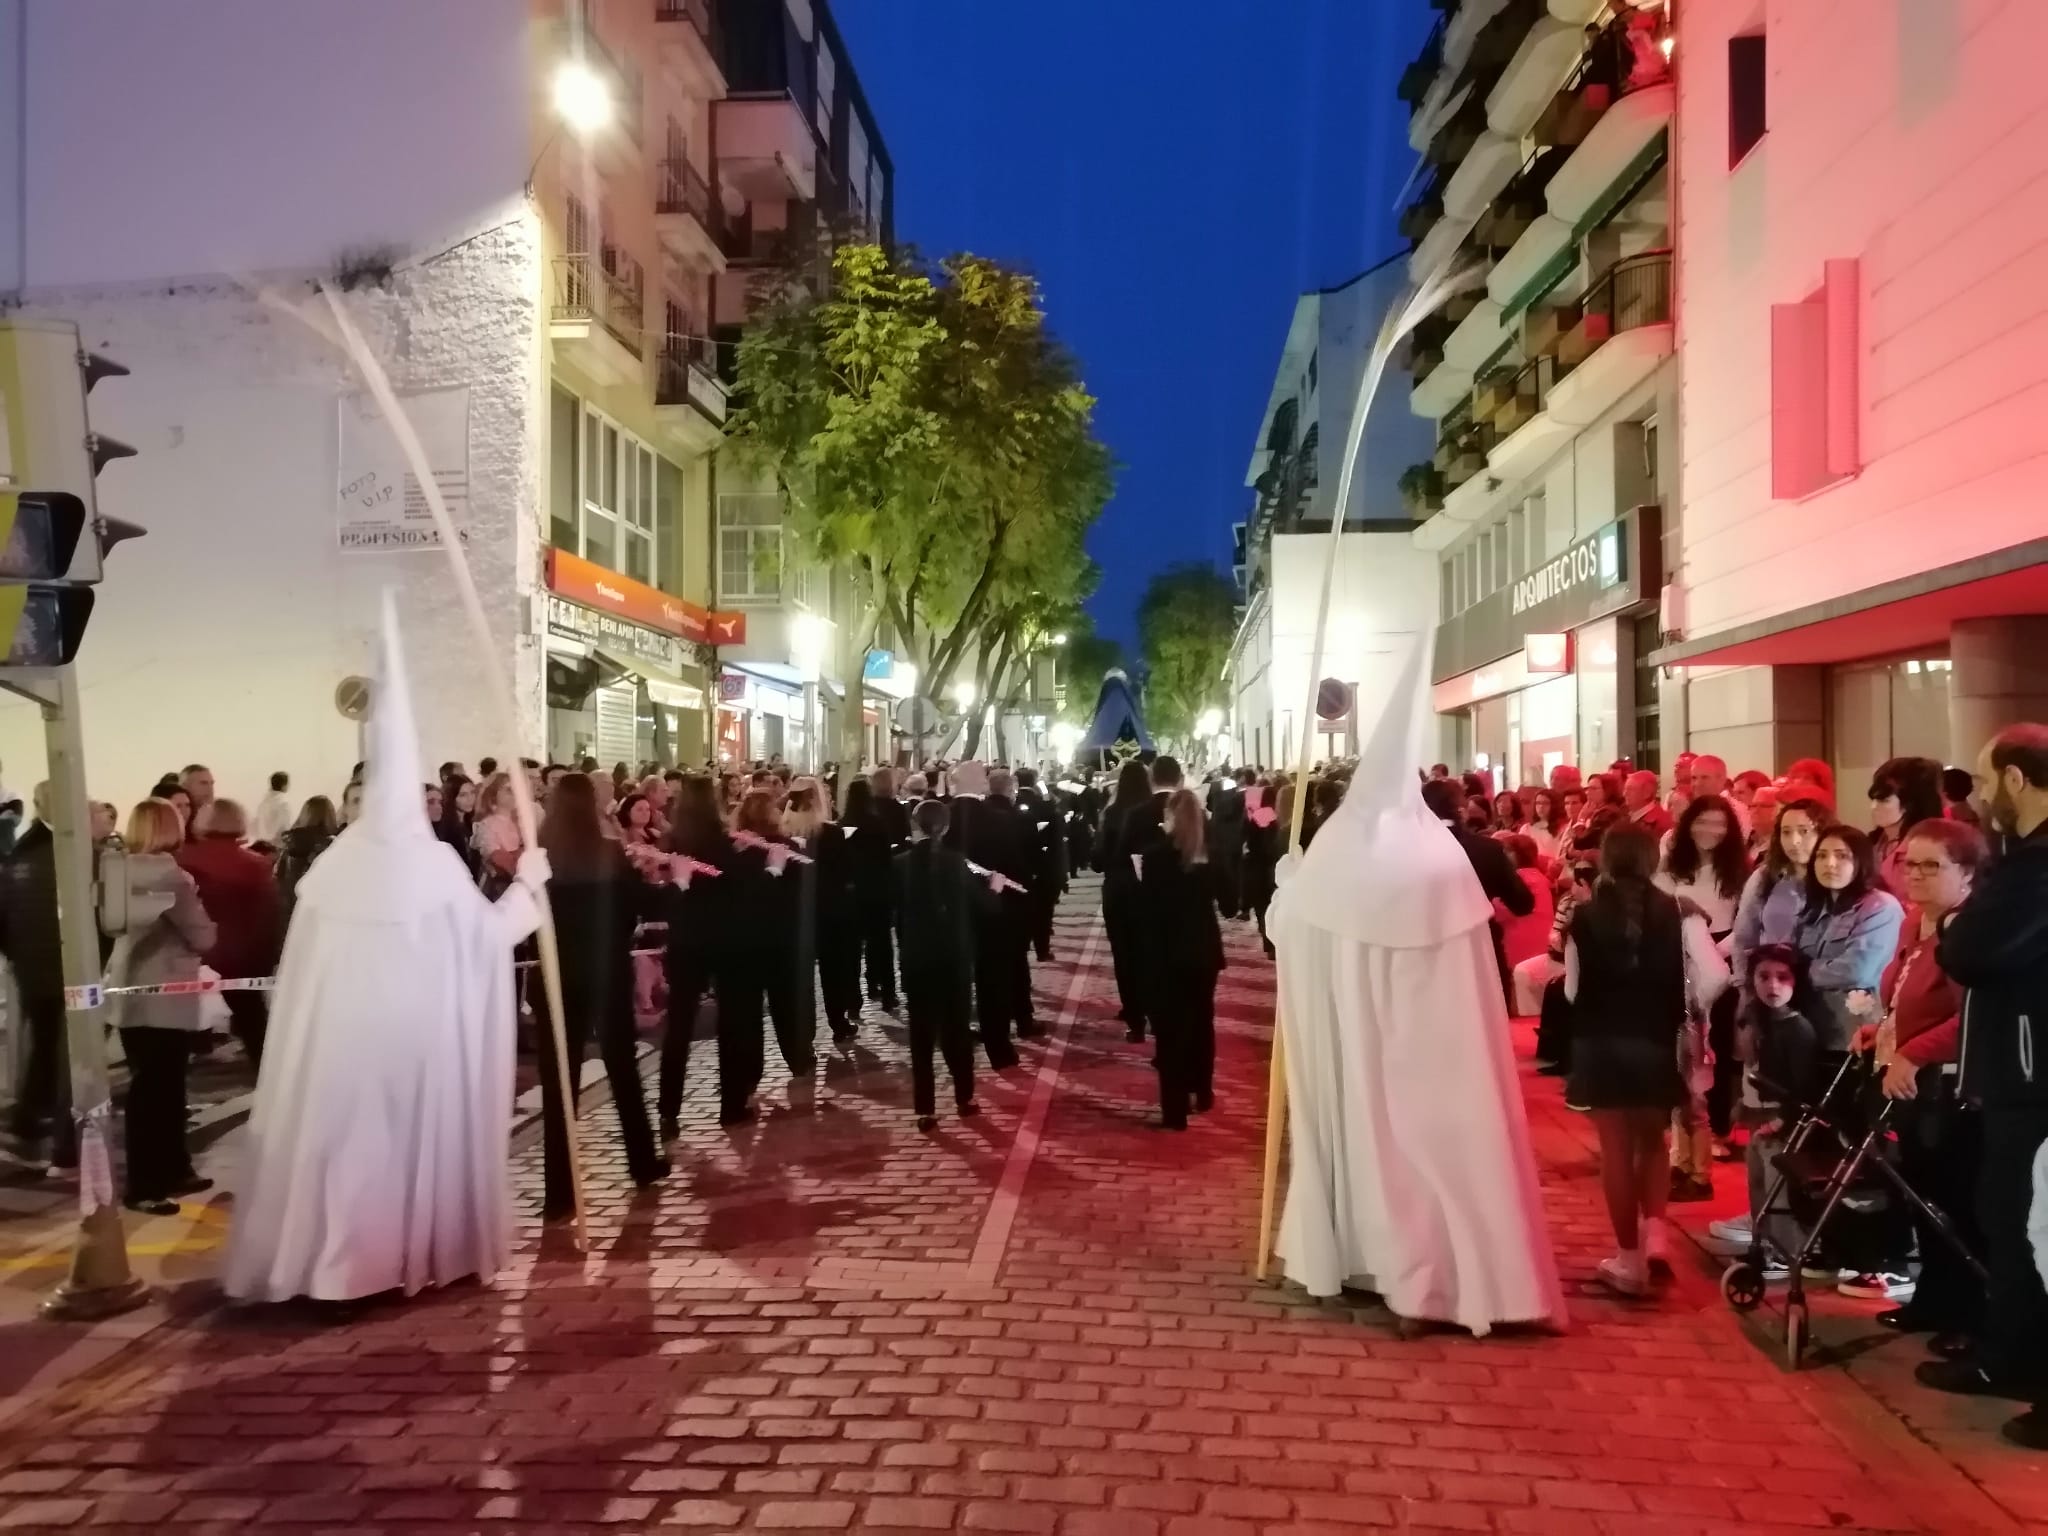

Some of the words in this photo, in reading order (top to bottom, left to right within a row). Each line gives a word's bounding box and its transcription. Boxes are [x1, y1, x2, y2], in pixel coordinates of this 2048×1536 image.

[340, 471, 377, 500] FOTO
[1512, 538, 1597, 616] ARQUITECTOS
[600, 617, 617, 635] BENI
[618, 623, 635, 639] AMIR
